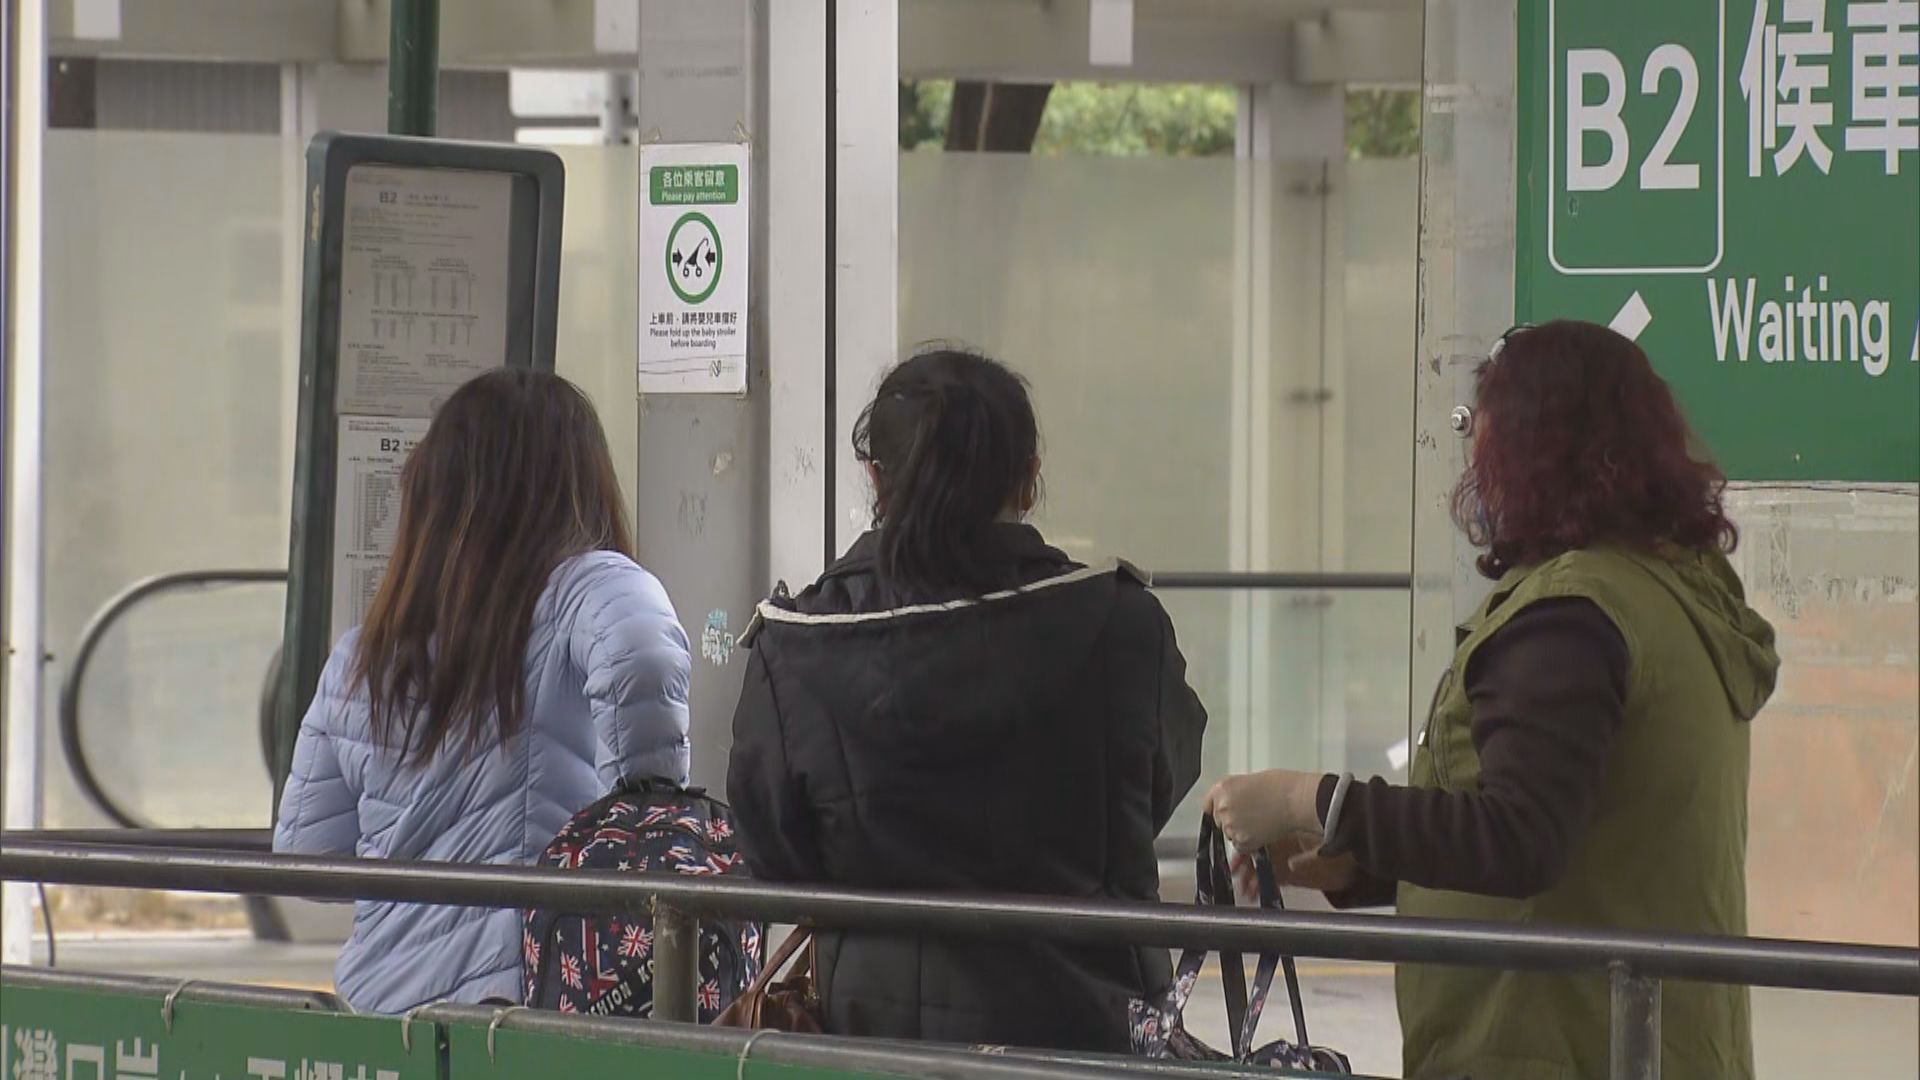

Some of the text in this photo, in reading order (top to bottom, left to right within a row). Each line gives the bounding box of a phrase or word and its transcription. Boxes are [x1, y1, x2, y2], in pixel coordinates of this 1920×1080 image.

[1565, 44, 1701, 192] B2
[662, 170, 725, 187] 各位乘客留意
[661, 190, 726, 203] Please pay attention
[650, 327, 736, 338] Please fold up the baby stroller
[1707, 275, 1891, 377] Waiting
[670, 339, 716, 349] before boarding
[380, 438, 401, 453] B2
[585, 981, 632, 1015] SHION
